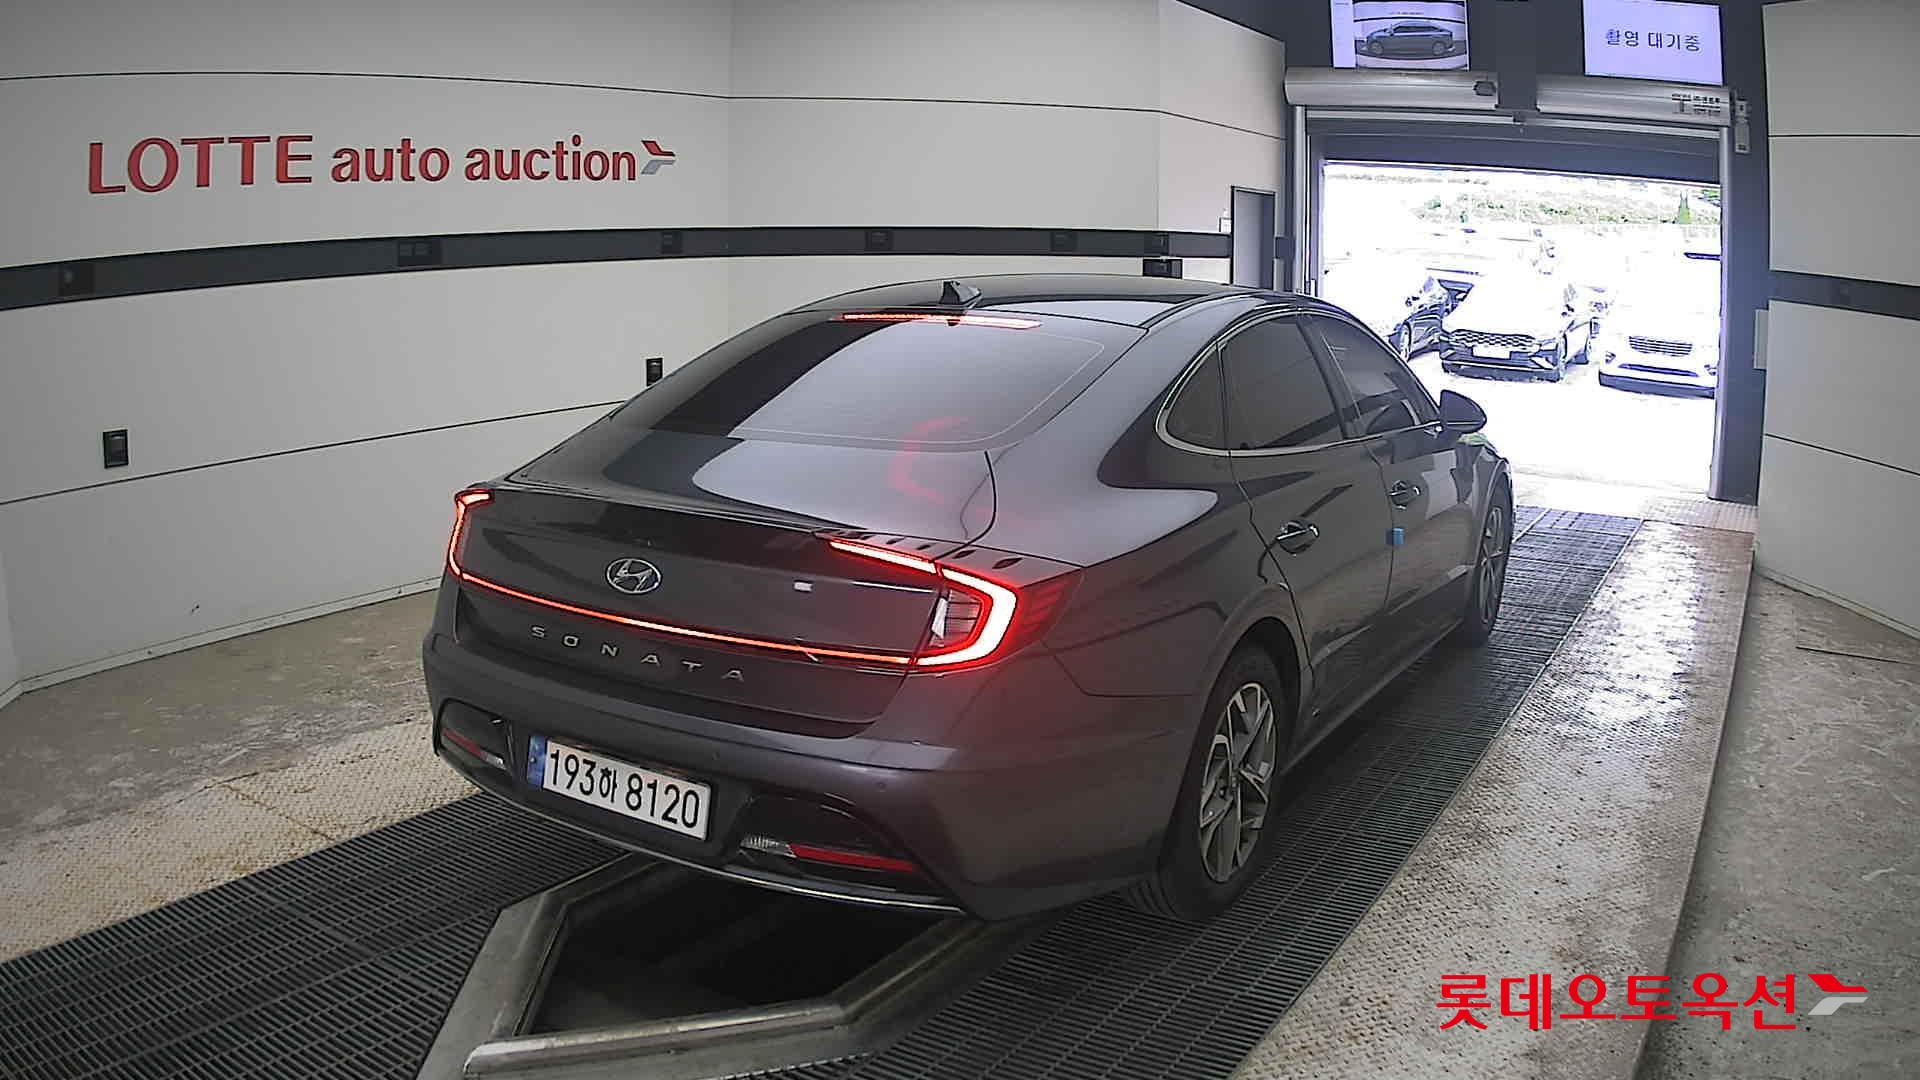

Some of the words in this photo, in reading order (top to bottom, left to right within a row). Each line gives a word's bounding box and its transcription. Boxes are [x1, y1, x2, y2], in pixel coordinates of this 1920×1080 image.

[88, 135, 313, 194] LOTTE
[330, 137, 450, 182] auto
[464, 134, 637, 182] auction
[531, 626, 745, 682] SONATA
